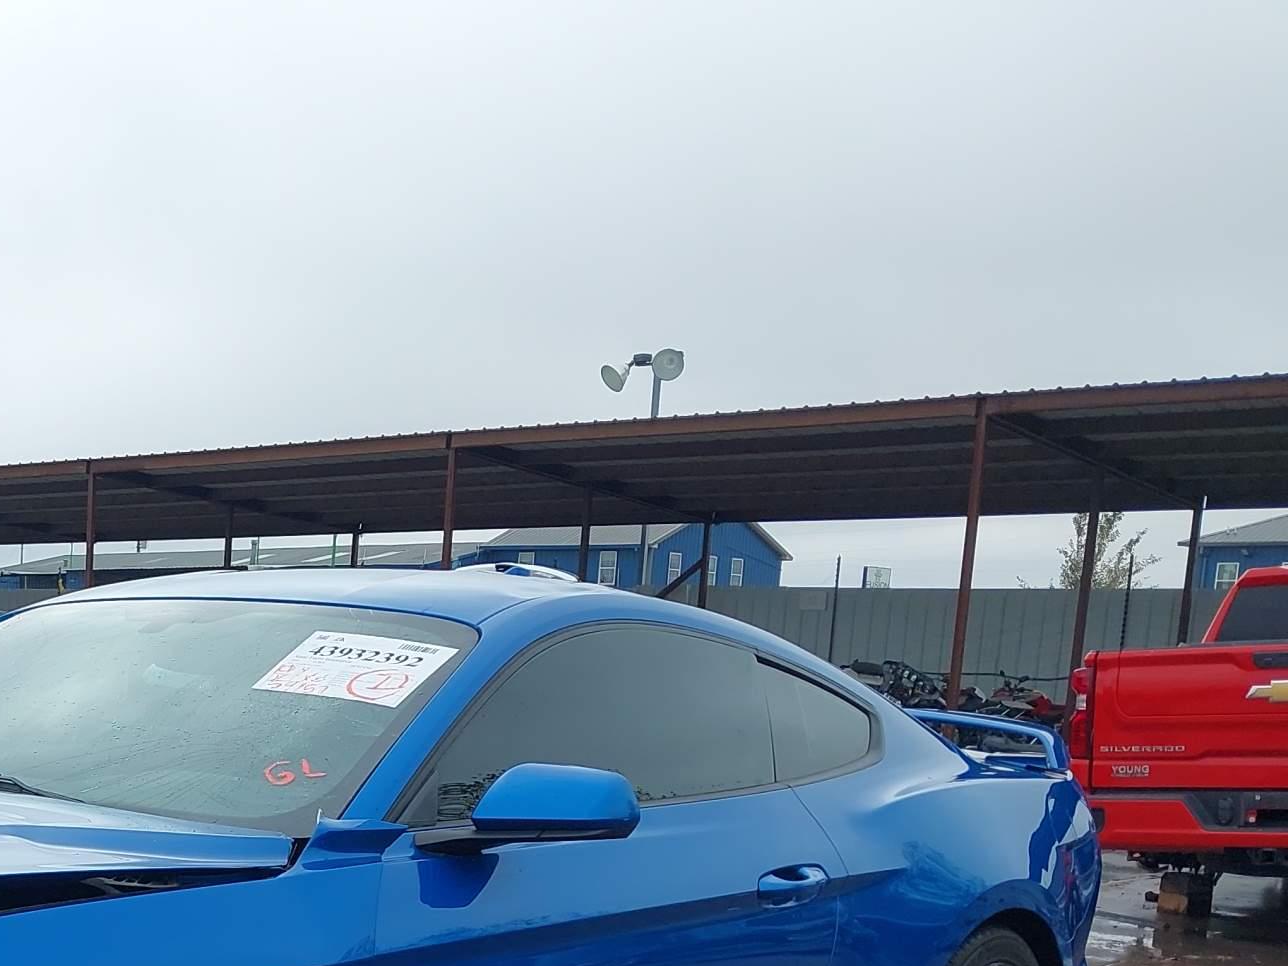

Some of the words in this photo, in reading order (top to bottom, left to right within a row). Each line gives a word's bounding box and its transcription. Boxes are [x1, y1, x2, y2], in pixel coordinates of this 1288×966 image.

[308, 645, 424, 668] 43932392
[1099, 745, 1186, 753] SILVERADO
[1111, 765, 1150, 774] YOUNG
